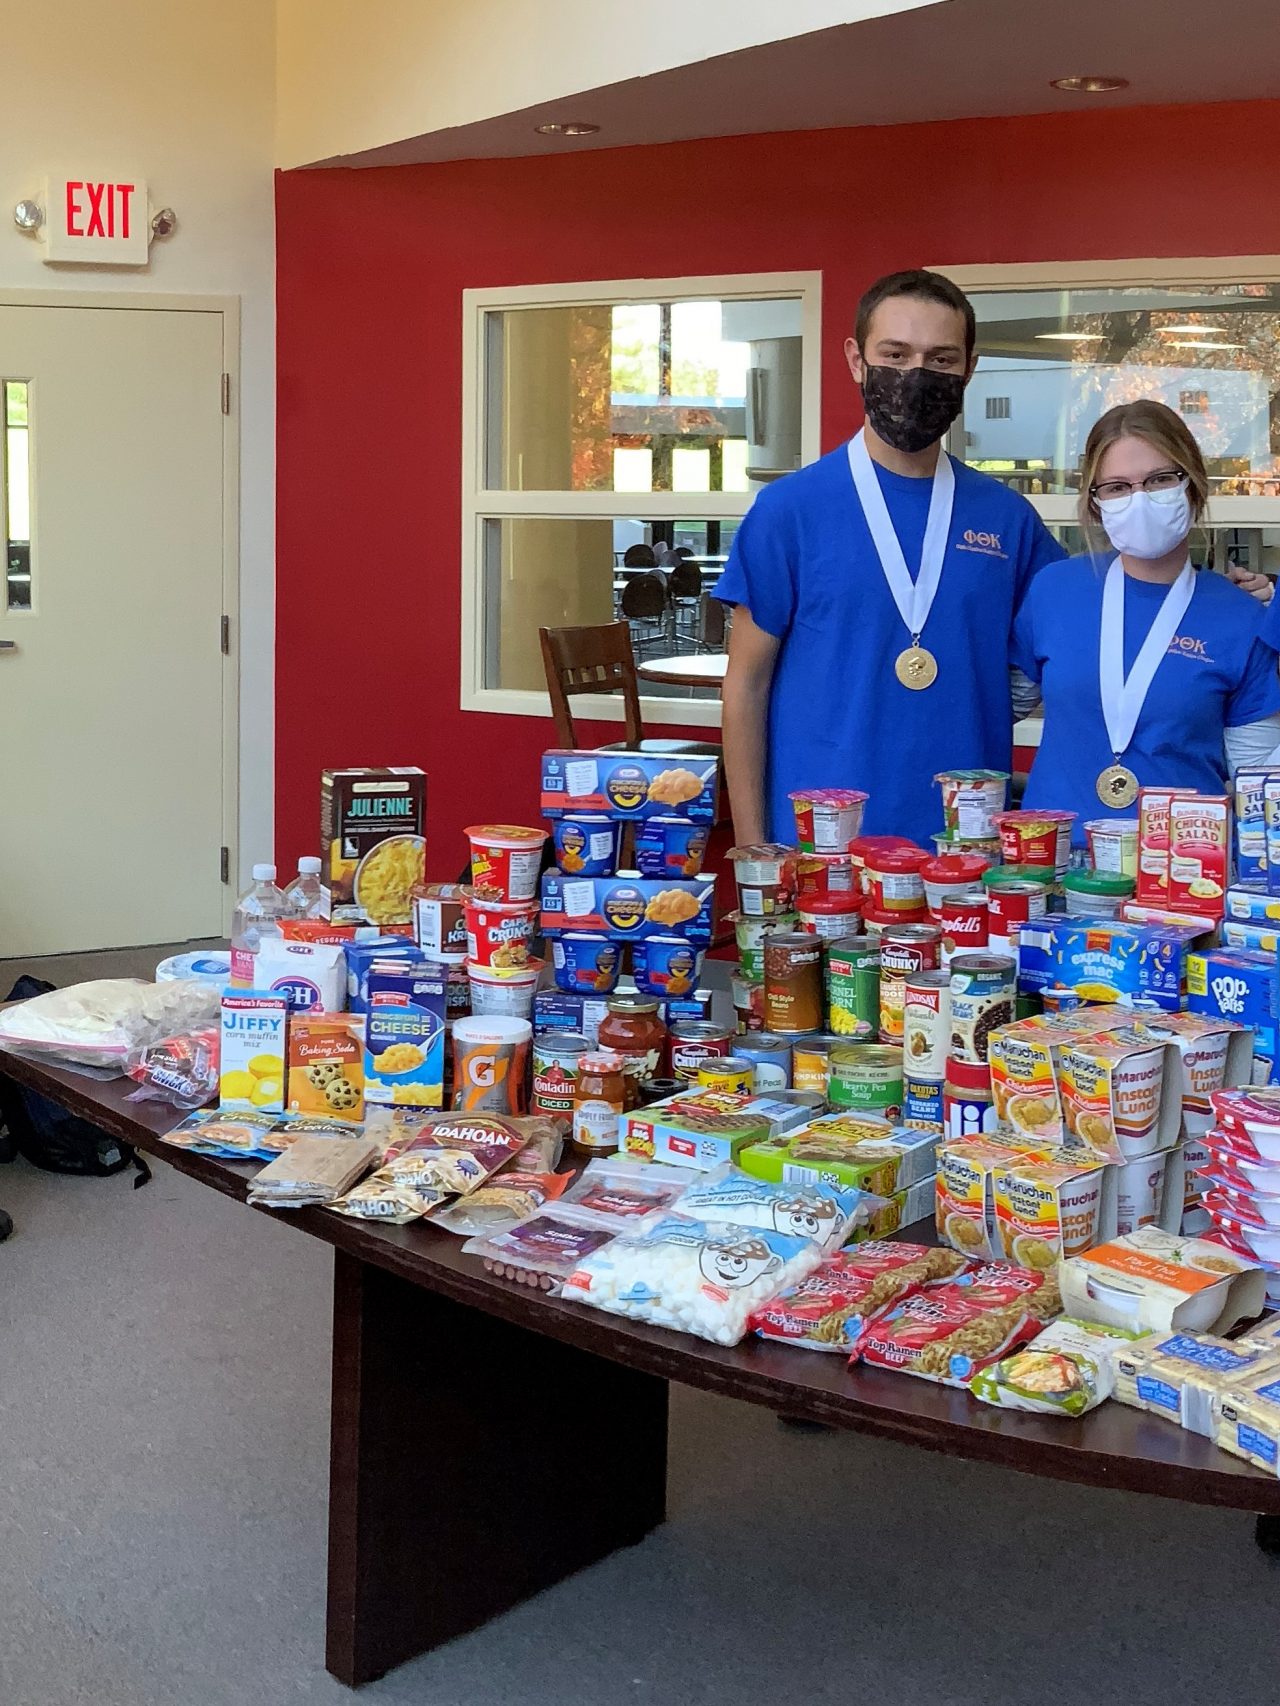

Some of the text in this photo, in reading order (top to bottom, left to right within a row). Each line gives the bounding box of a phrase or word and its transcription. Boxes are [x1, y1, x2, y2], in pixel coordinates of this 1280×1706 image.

[66, 181, 135, 239] EXIT
[1248, 793, 1263, 804] TU
[347, 797, 414, 817] JULIENNE
[1146, 813, 1170, 823] CHIC
[1148, 823, 1169, 833] SAL
[1175, 820, 1221, 832] CHICKEN
[1177, 829, 1219, 842] SALAD
[236, 952, 254, 961] CHE
[1162, 944, 1171, 956] 4
[881, 953, 919, 971] CHUNKY
[1071, 952, 1126, 971] express
[1083, 965, 1114, 979] mac
[222, 1000, 255, 1008] America's
[906, 991, 936, 1008] LINDSAY
[224, 1013, 281, 1031] JIFFY
[370, 1012, 420, 1021] macaroni
[225, 1030, 279, 1041] corn muffin
[370, 1021, 431, 1036] CHEESE
[243, 1040, 260, 1049] mix
[300, 1043, 356, 1056] Baking Soda
[1001, 1041, 1046, 1061] Maruchan
[467, 1056, 496, 1087] G
[1008, 1065, 1033, 1078] Lunch
[152, 1067, 198, 1095] SNICK
[534, 1076, 576, 1094] Contadin
[762, 1079, 782, 1087] Peas
[842, 1081, 887, 1092] Hearty Pea
[851, 1090, 872, 1100] Soup
[541, 1100, 570, 1109] DICED
[431, 1126, 511, 1145] IDAHOAN
[1005, 1177, 1053, 1201] Maruchan
[726, 1194, 741, 1202] HOT
[1009, 1192, 1040, 1209] Instant
[1061, 1189, 1099, 1207] arucha
[1013, 1203, 1039, 1217] Lunch
[1061, 1208, 1095, 1225] stant
[1063, 1223, 1092, 1240] unch
[1124, 1255, 1180, 1276] Pad Thai
[766, 1312, 819, 1329] Top Ramen
[868, 1338, 922, 1358] Top Ramen
[885, 1352, 906, 1363] BEEF
